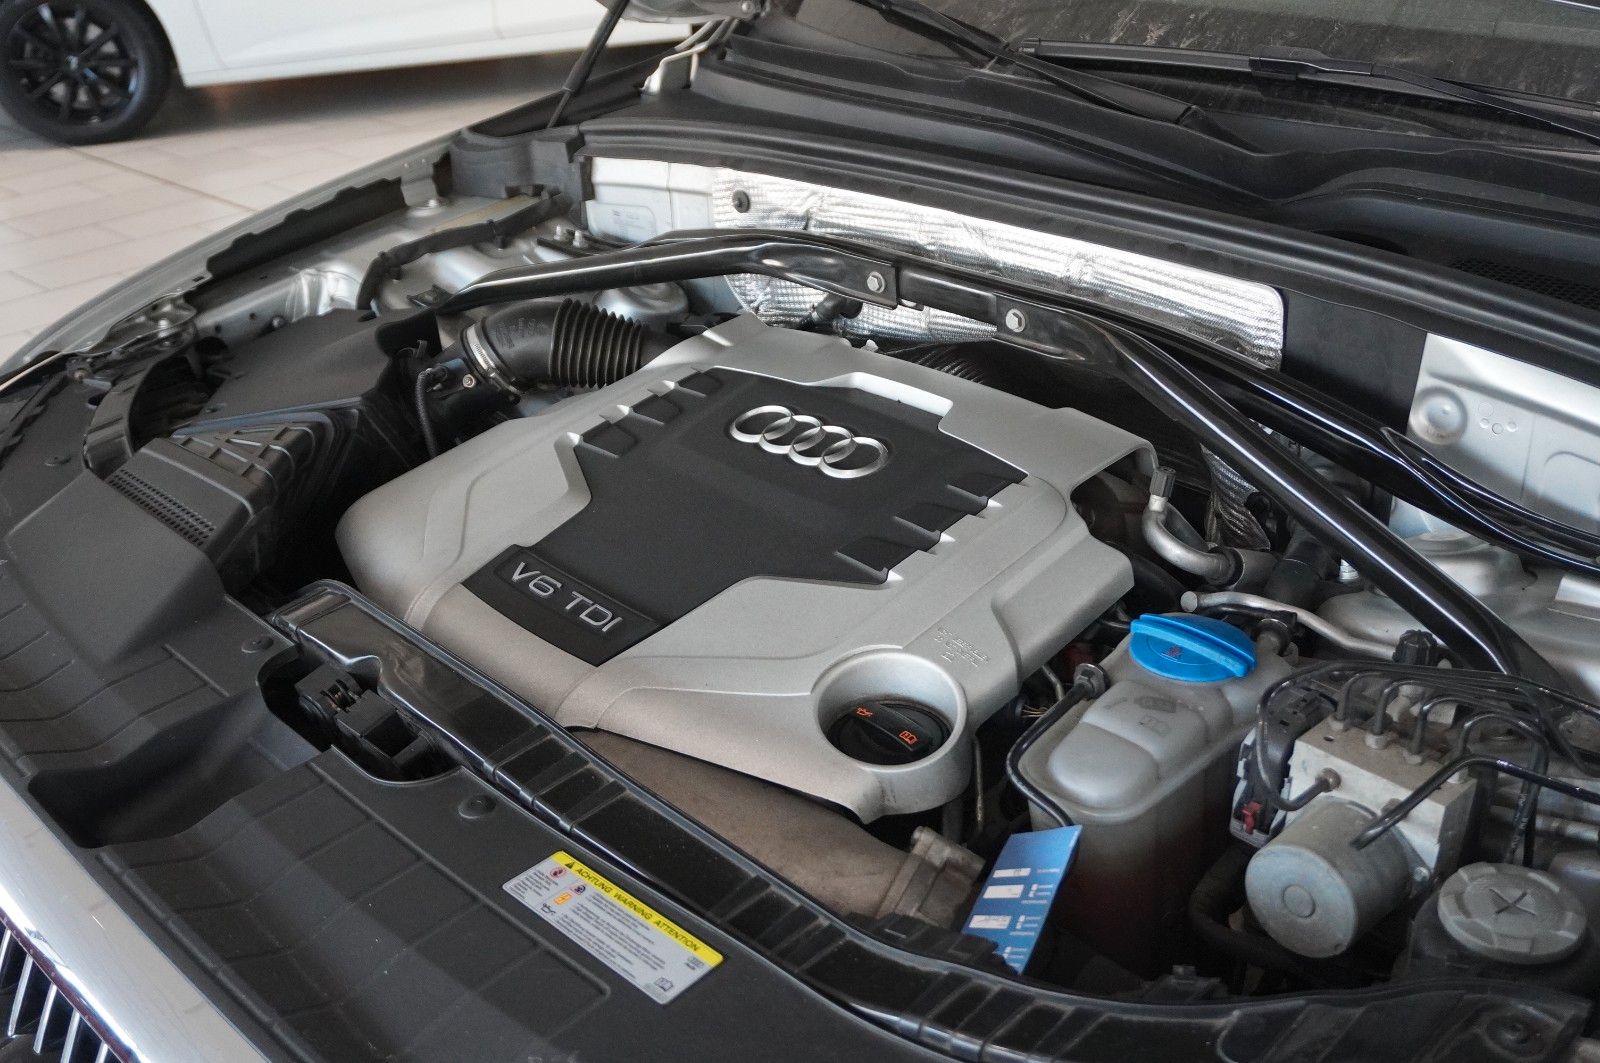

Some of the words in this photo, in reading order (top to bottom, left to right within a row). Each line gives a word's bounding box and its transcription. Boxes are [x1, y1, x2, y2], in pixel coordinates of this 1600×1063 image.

[512, 562, 562, 596] V6
[565, 591, 622, 632] TDI
[576, 868, 613, 893] ACHTUNG
[614, 892, 653, 920] WARNING
[654, 919, 699, 951] ATTENTION
